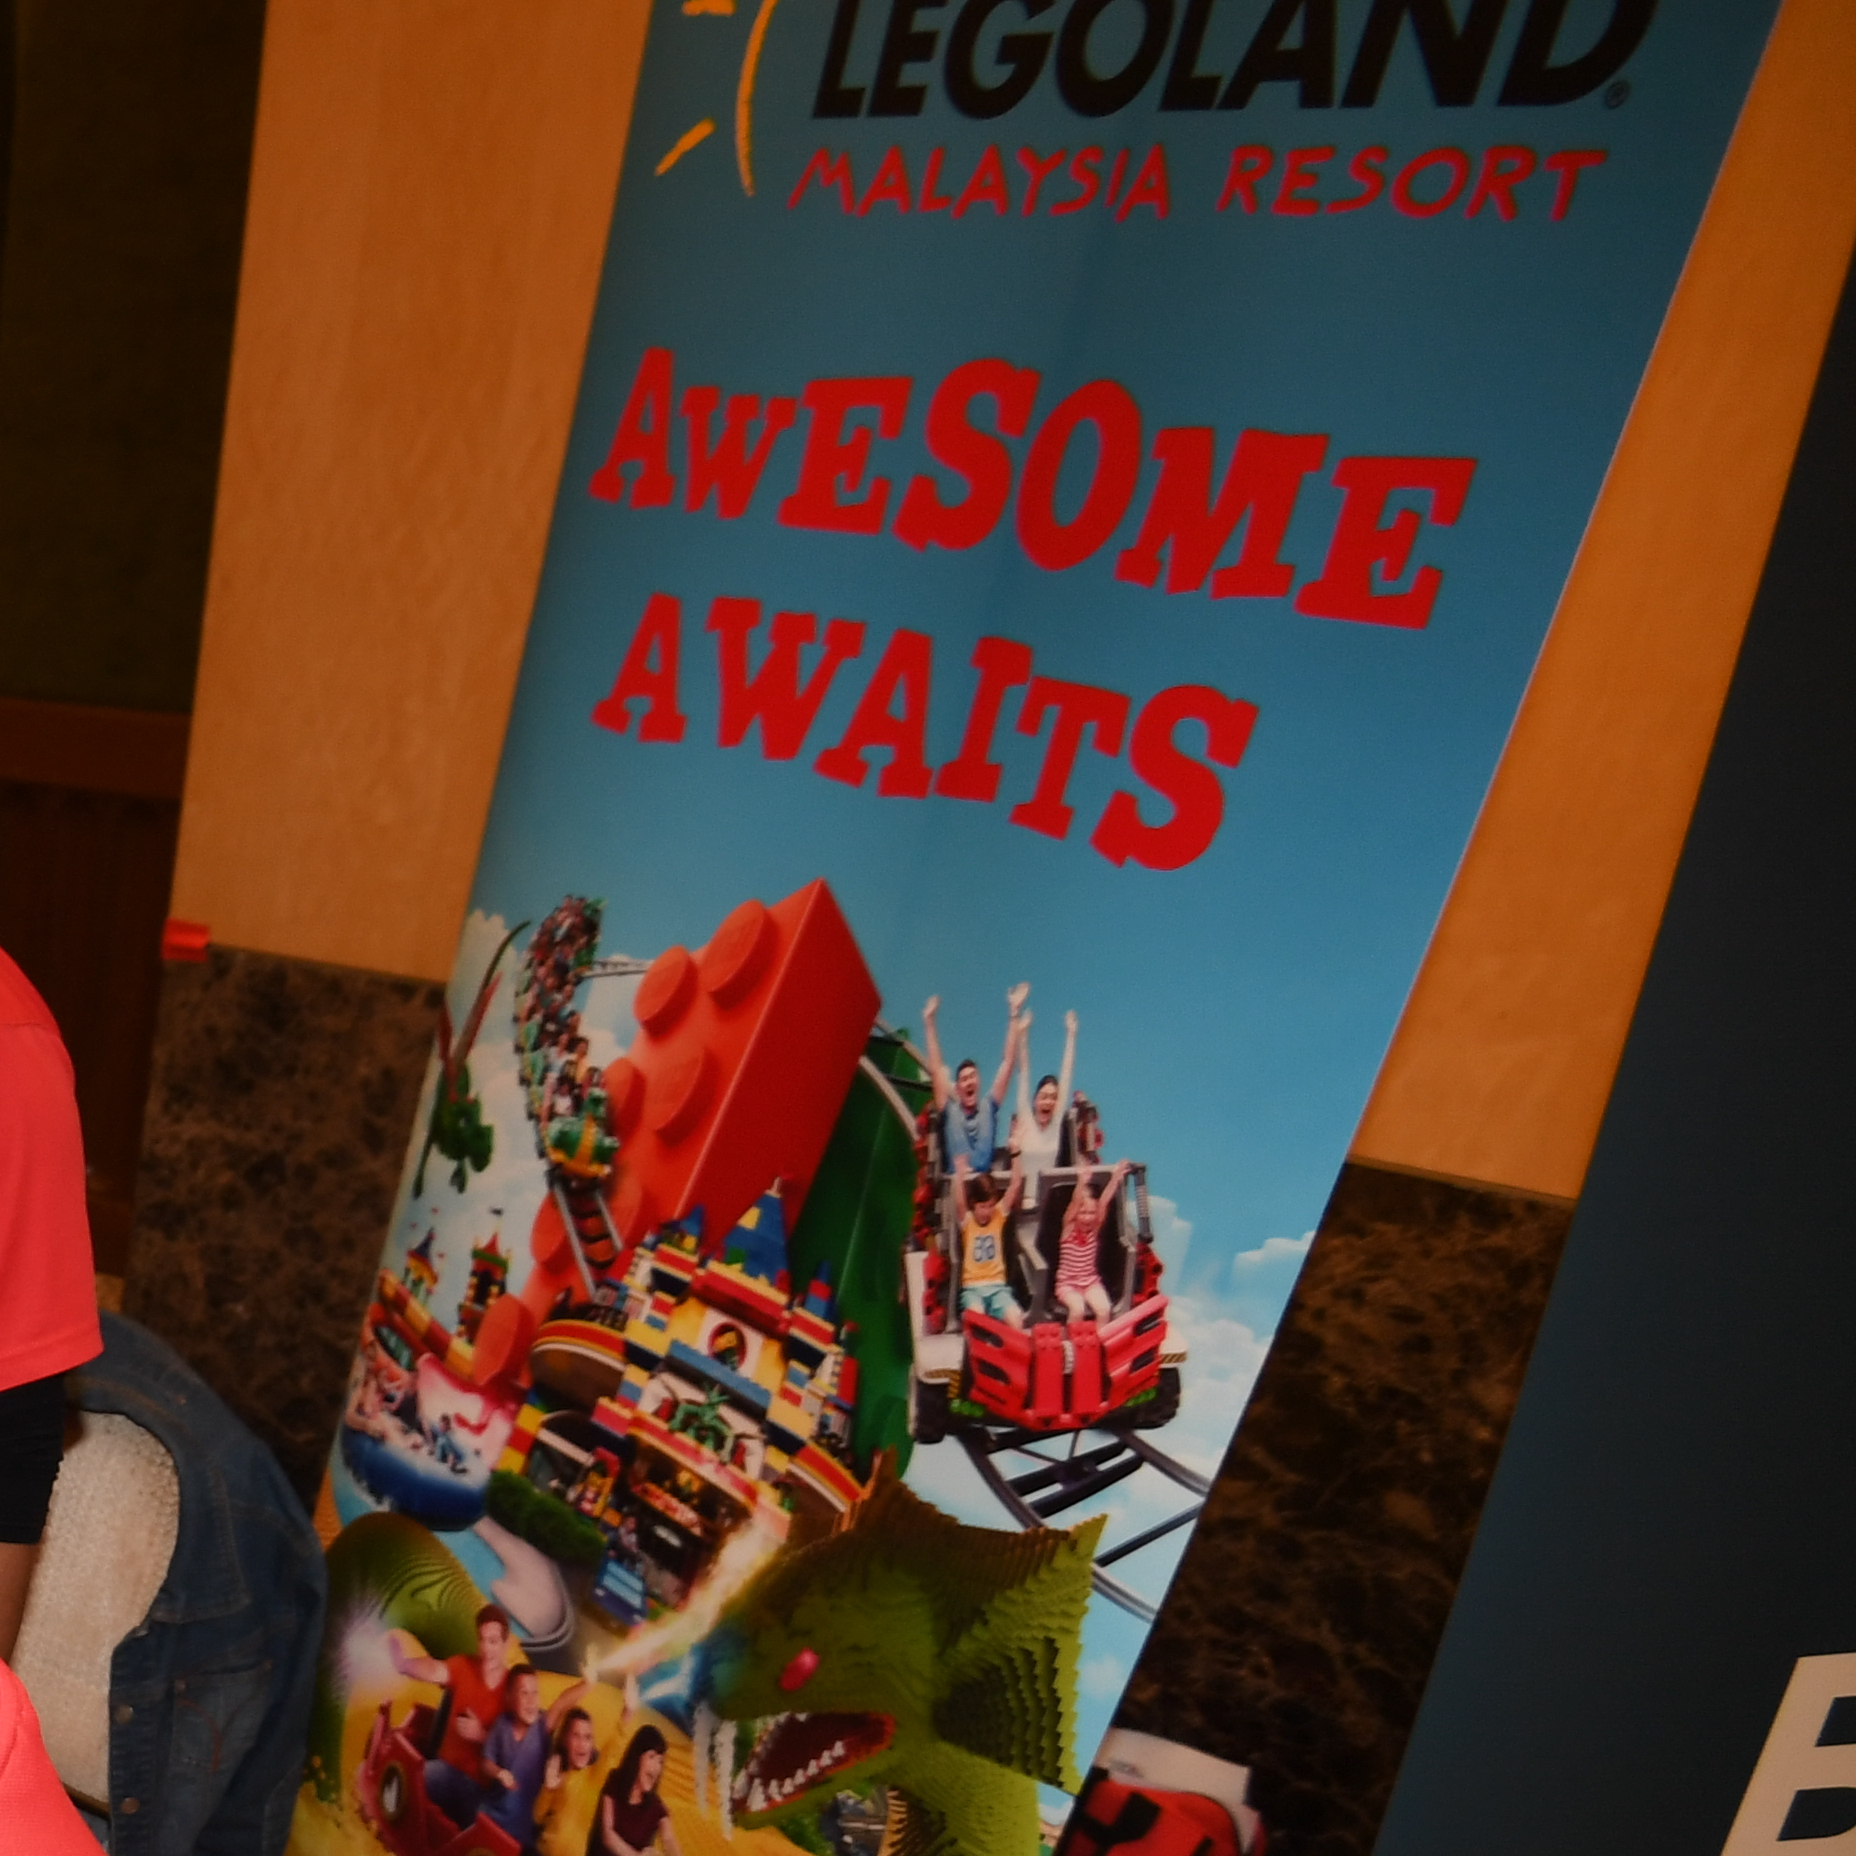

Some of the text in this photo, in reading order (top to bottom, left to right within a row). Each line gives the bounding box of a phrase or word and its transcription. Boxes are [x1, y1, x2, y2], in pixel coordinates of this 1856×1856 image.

[786, 143, 1608, 226] MALAYSIA RESORT
[588, 346, 1478, 631] AWESOME
[589, 590, 1261, 873] AWAITS
